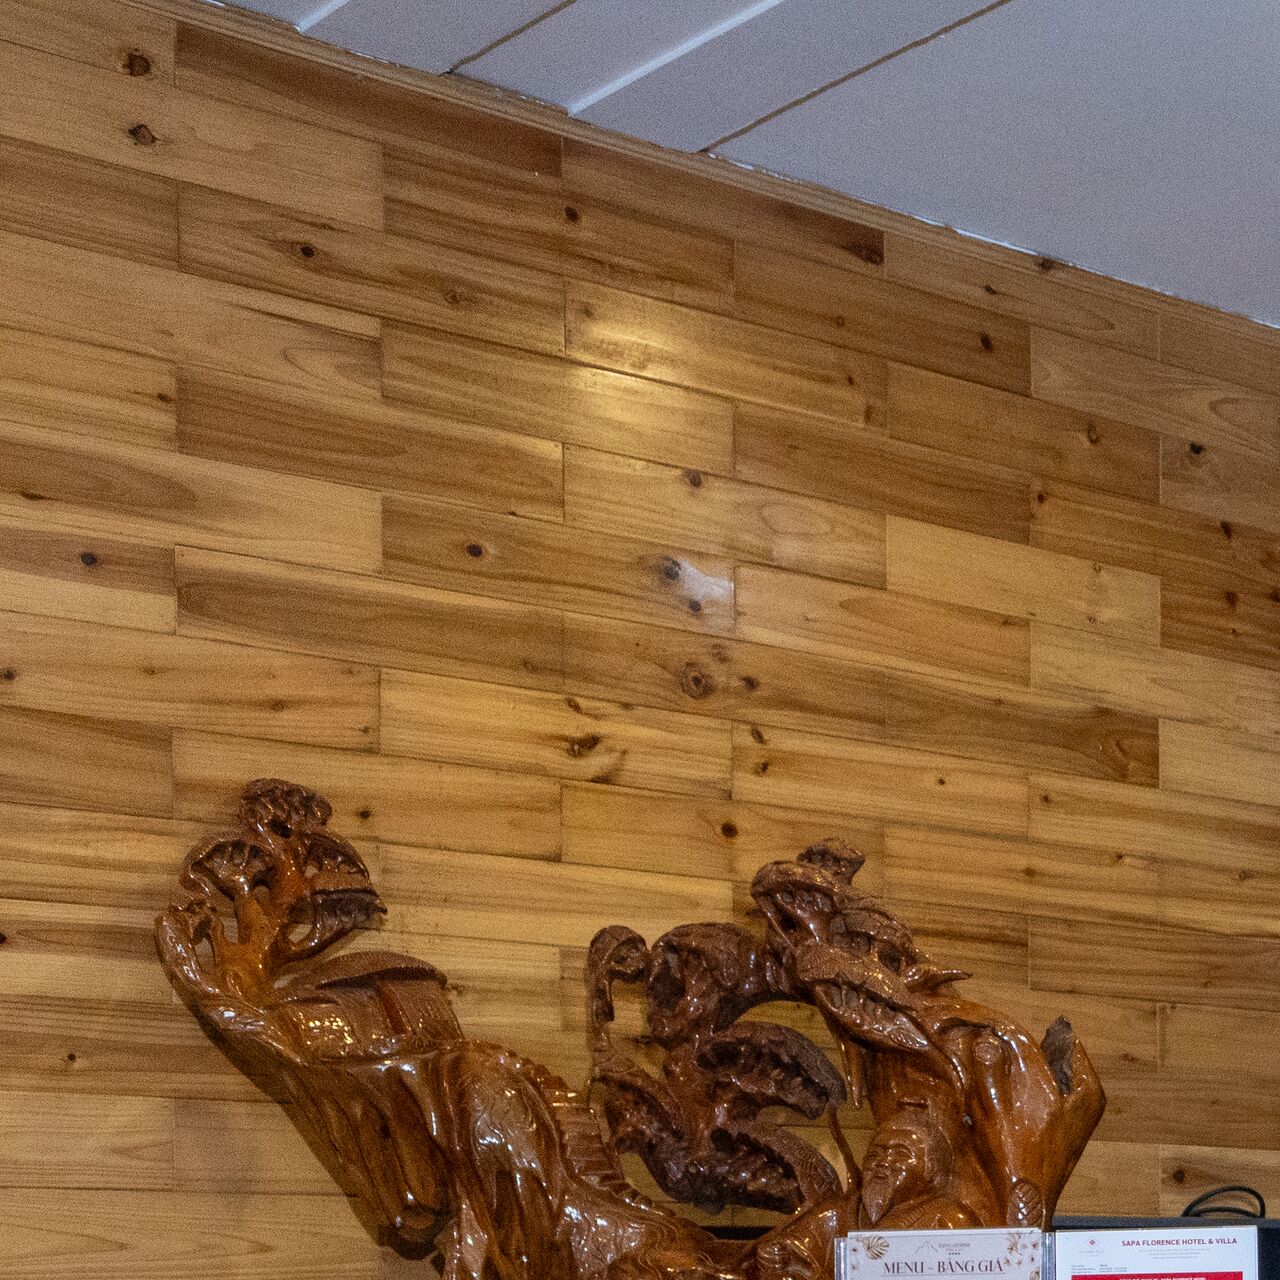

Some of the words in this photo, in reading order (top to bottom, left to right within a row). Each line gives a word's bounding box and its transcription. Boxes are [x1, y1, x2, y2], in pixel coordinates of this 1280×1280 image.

[884, 1261, 924, 1274] MENU
[938, 1257, 974, 1273] BẢNG
[978, 1256, 1003, 1272] GIÁ
